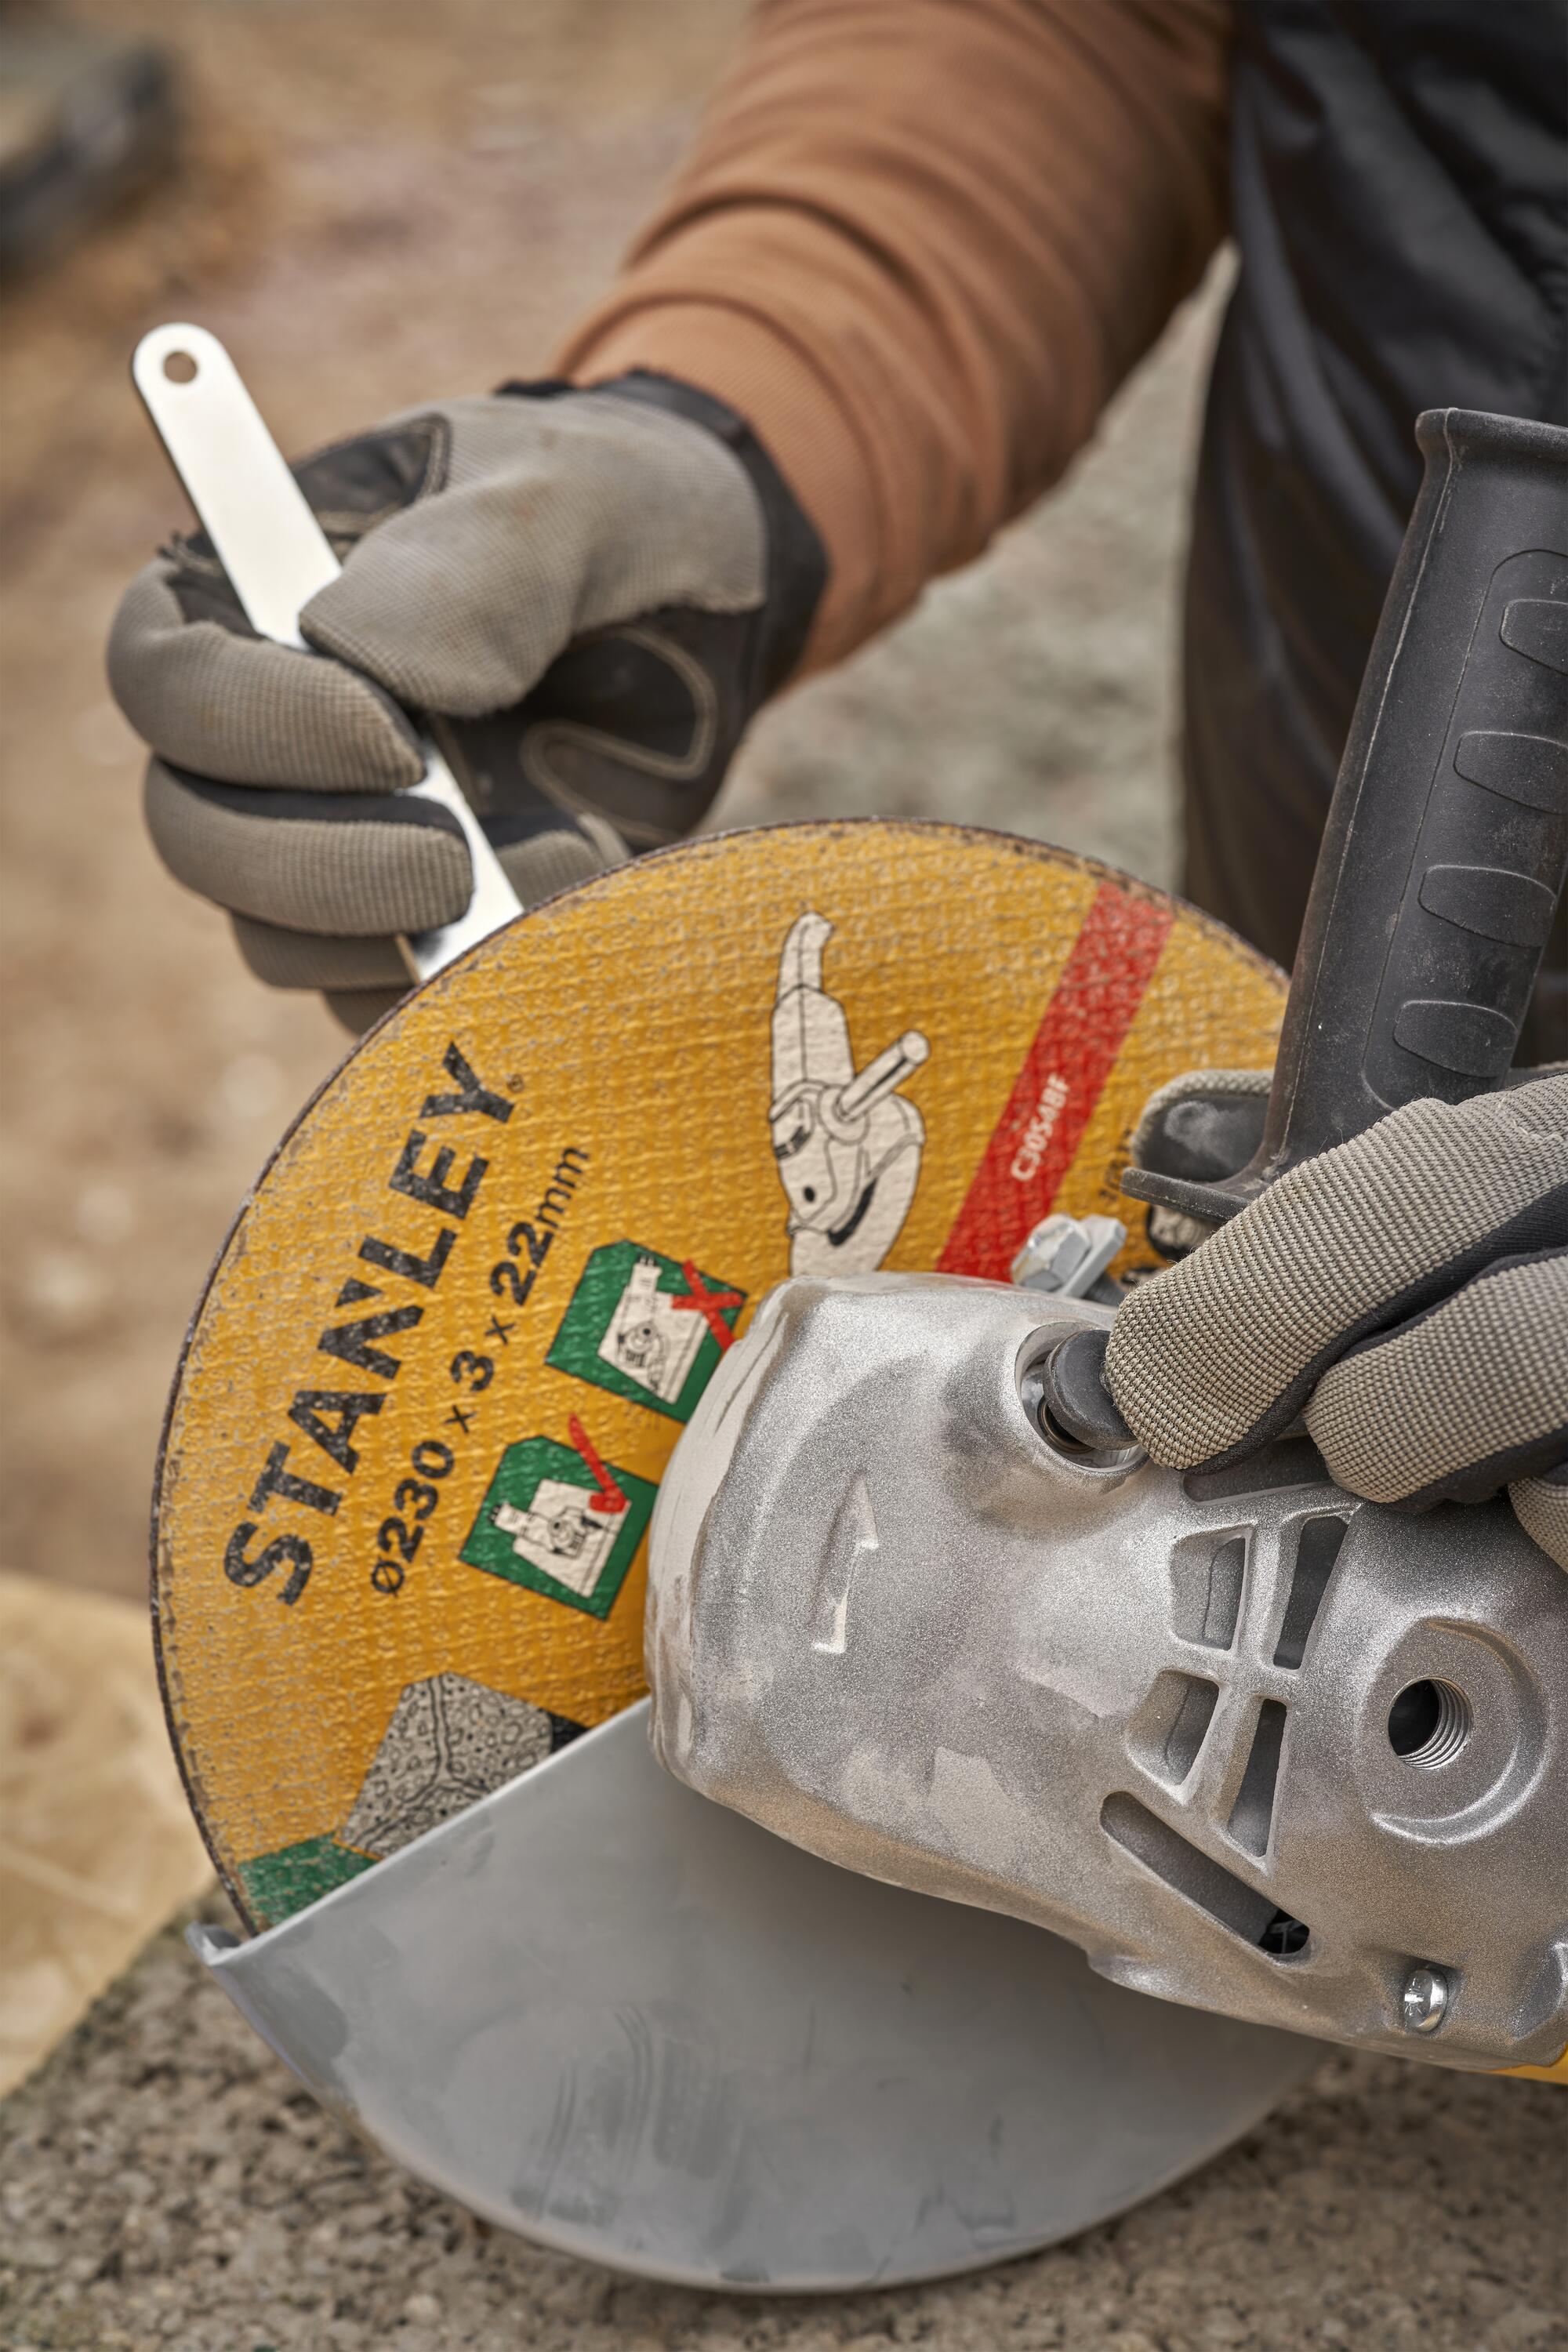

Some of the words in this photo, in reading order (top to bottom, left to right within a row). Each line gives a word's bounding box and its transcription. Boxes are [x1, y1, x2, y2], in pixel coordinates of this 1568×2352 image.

[223, 1042, 515, 1606] STANLEY
[450, 1350, 494, 1392] 3
[490, 1147, 590, 1306] 22mm
